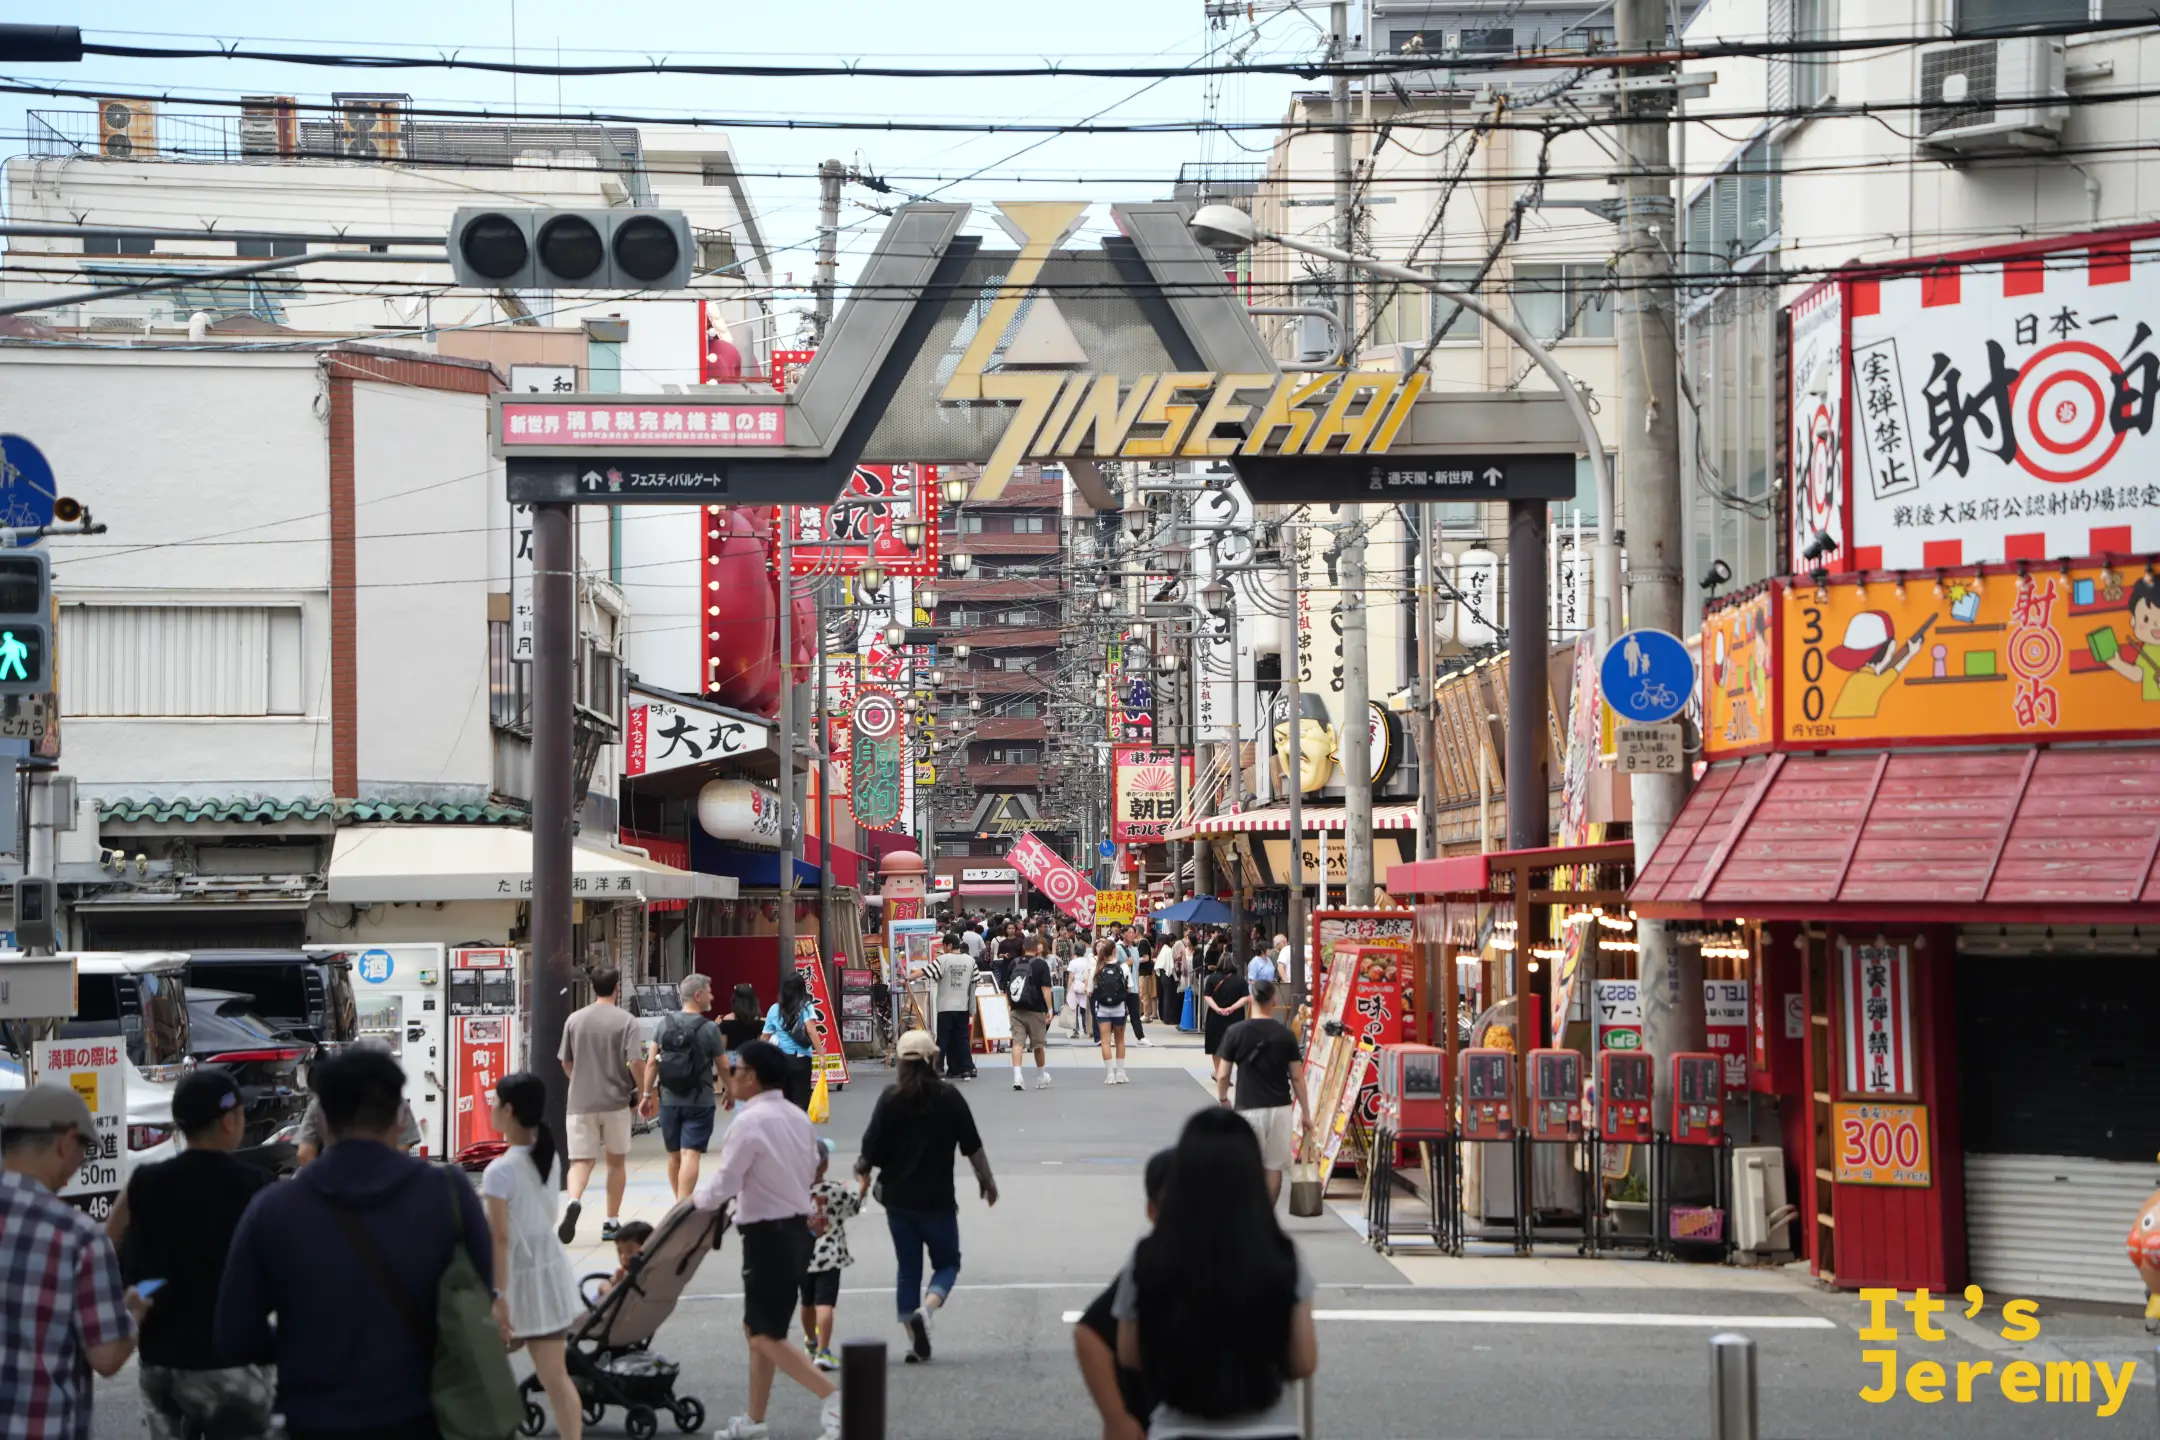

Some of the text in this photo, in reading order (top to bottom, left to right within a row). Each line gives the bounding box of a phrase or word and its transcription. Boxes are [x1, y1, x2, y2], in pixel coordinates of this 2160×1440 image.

[2014, 304, 2120, 348] 日本一
[510, 410, 778, 434] 新世界 消費税完納推進の街
[1861, 350, 1911, 492] 実弾禁止
[630, 473, 722, 487] フェスティバルゲート
[1387, 470, 1475, 485] 通天閣・新世界
[2009, 574, 2057, 729] 射的
[1802, 607, 1825, 722] 300
[650, 704, 677, 717] 味の
[656, 714, 746, 760] 大丸
[854, 736, 899, 820] 射的
[1130, 798, 1175, 821] 朝日
[573, 876, 632, 891] 和洋酒
[980, 870, 1002, 879] サン
[1097, 892, 1133, 901] 日本最大
[1098, 902, 1134, 914] 射的場
[1720, 985, 1748, 1001] TEL
[1866, 964, 1891, 1088] 実弾禁止
[48, 1046, 118, 1070] 満車の際は
[1723, 1054, 1746, 1086] 売
[1842, 1118, 1921, 1168] 300
[80, 1164, 117, 1186] 50m
